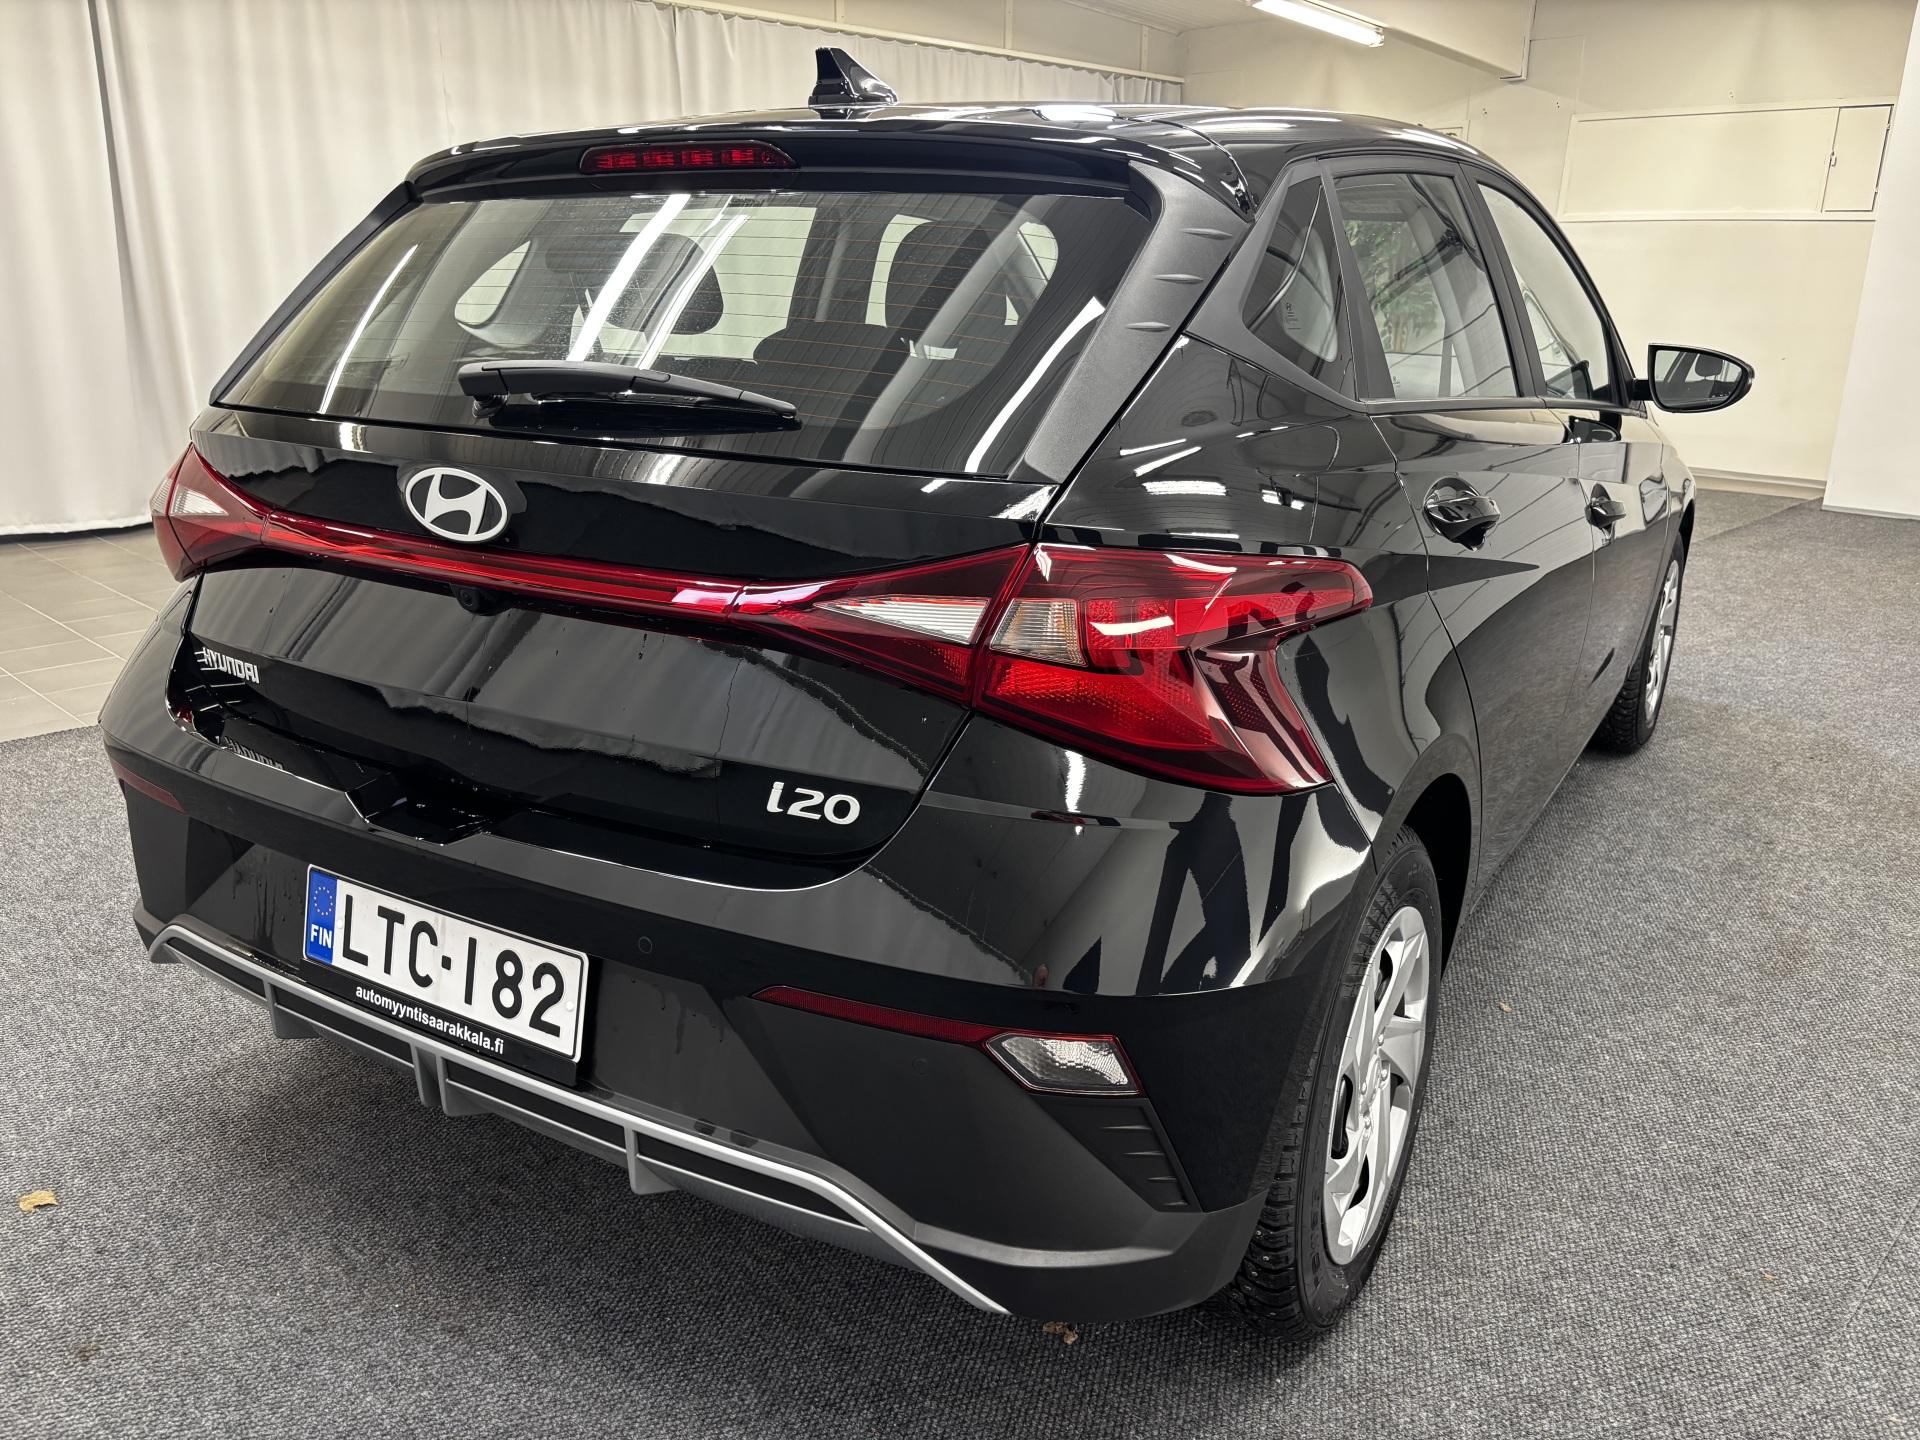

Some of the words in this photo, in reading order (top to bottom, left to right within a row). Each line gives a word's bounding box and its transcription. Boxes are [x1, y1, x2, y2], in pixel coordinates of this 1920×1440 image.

[202, 647, 259, 684] HYUNDAI
[310, 924, 333, 949] FIN
[342, 894, 565, 1038] LTC-182
[355, 984, 504, 1054] automyyntisaarakkala.fi
